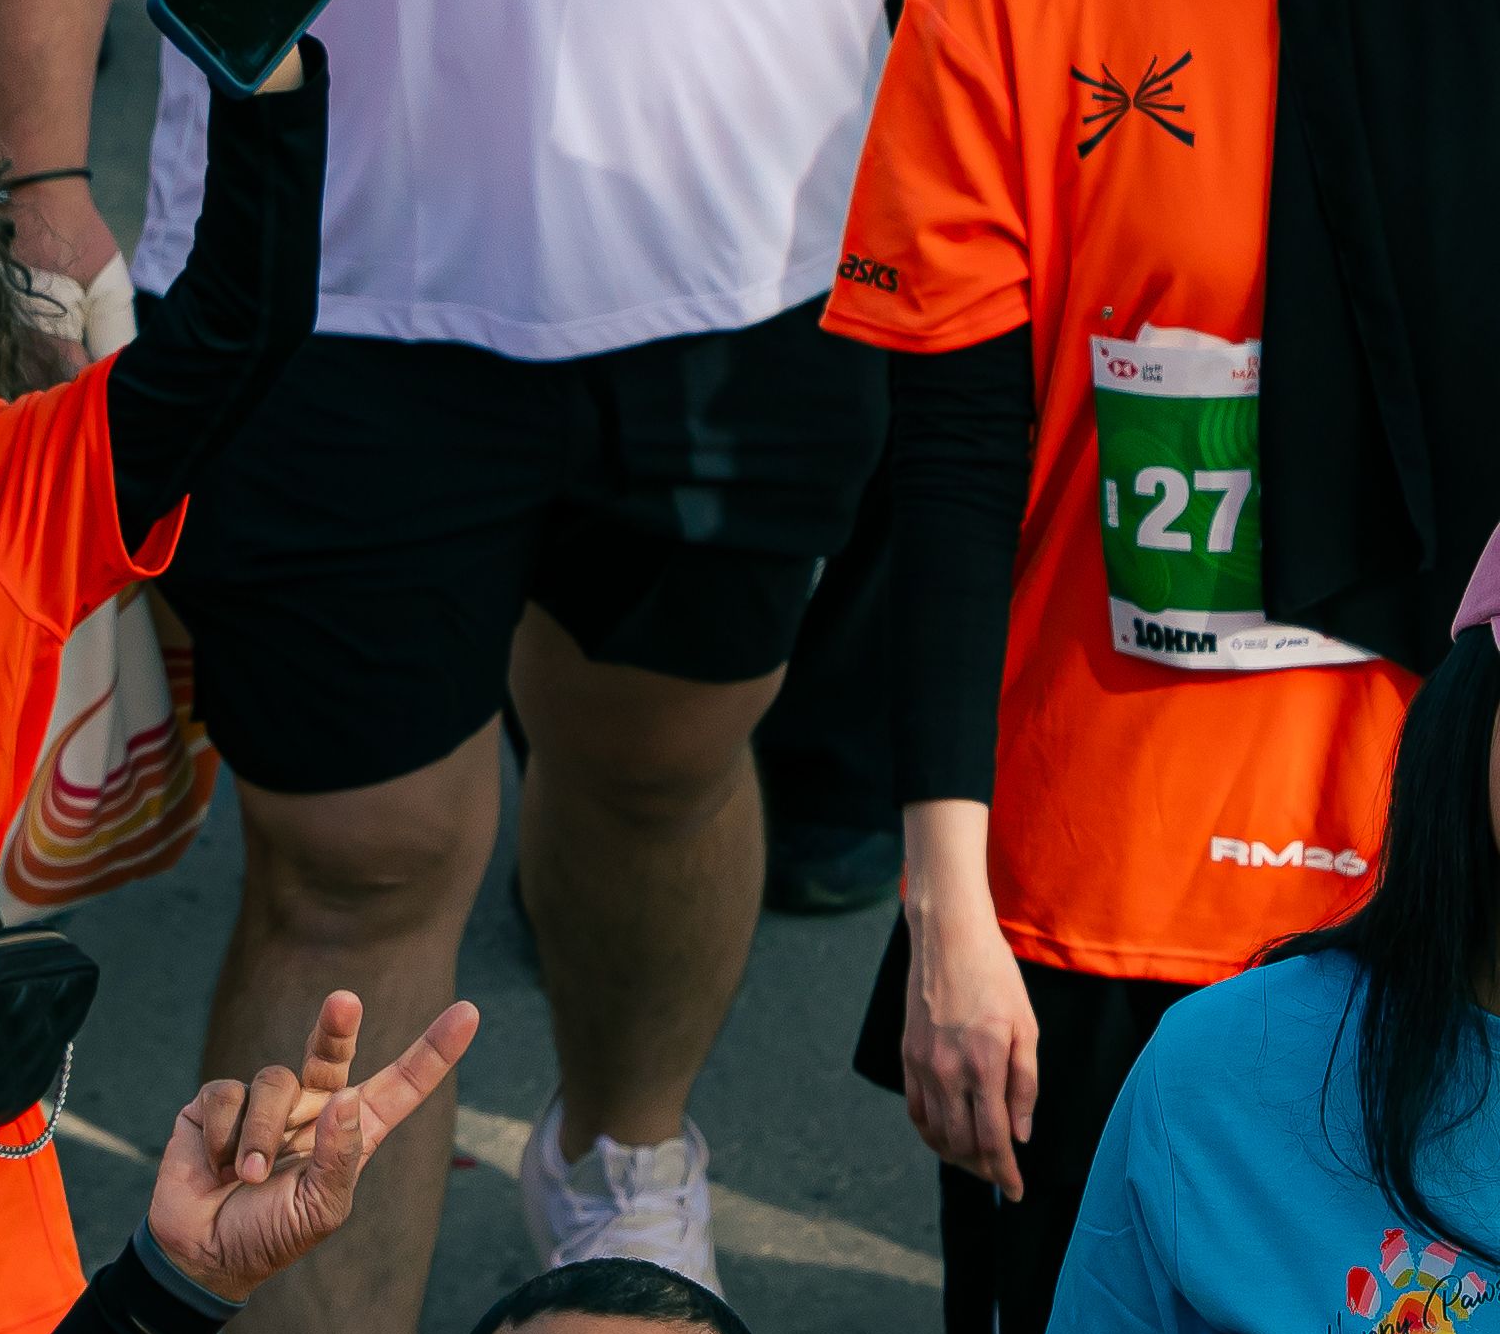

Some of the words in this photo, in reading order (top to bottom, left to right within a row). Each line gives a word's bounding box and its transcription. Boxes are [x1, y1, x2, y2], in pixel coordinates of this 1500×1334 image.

[837, 253, 900, 293] asics
[1135, 466, 1260, 554] 27
[1133, 617, 1218, 654] 10KM
[1210, 835, 1368, 877] RM26
